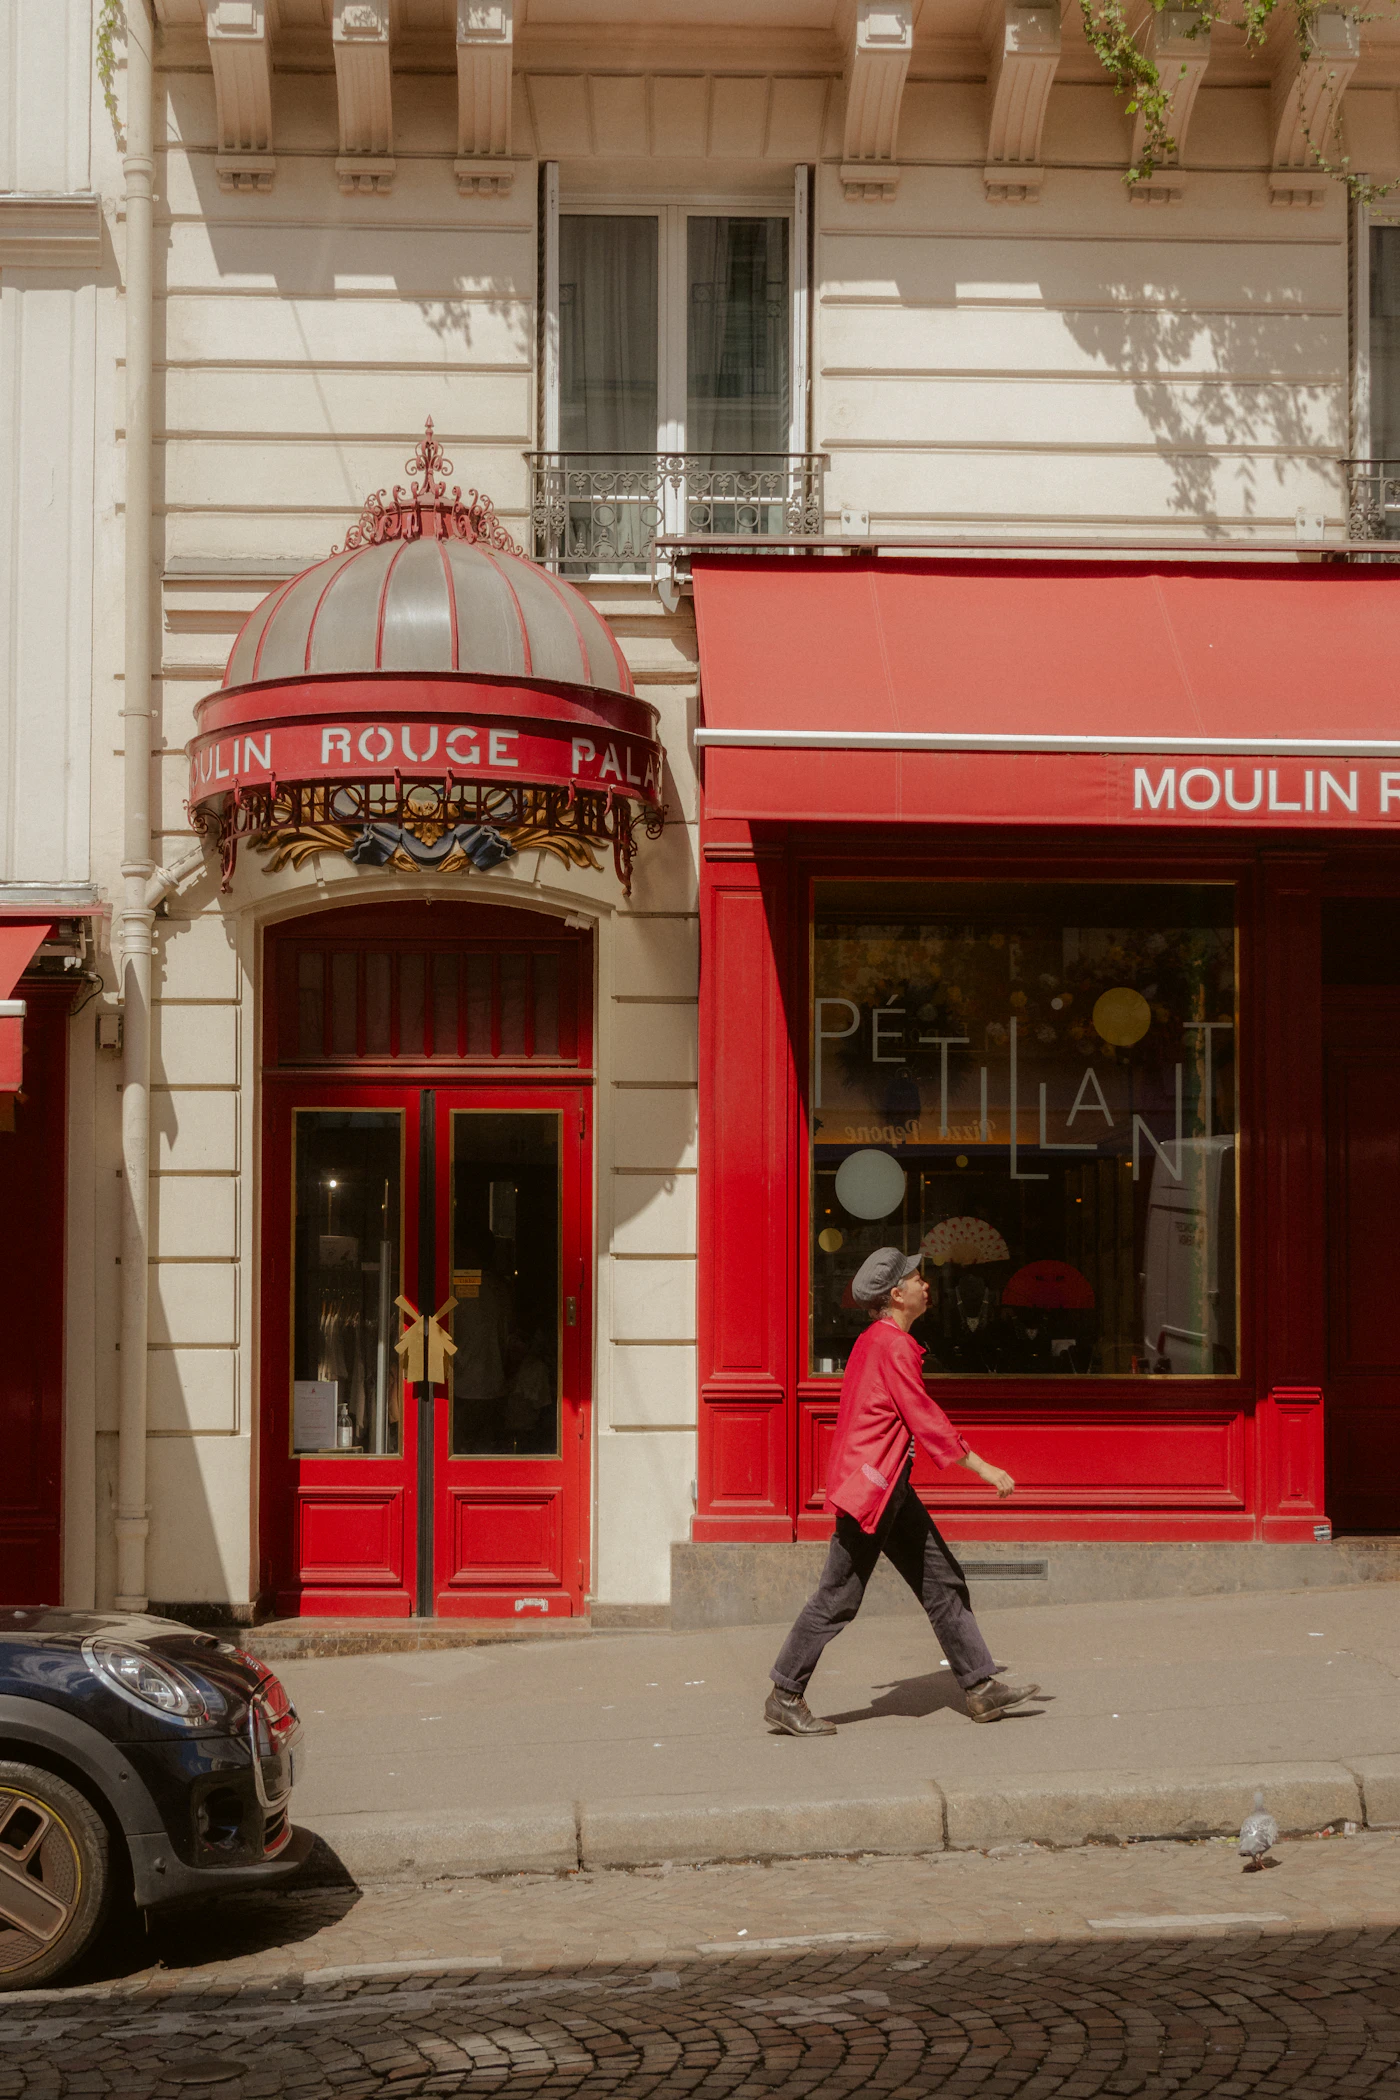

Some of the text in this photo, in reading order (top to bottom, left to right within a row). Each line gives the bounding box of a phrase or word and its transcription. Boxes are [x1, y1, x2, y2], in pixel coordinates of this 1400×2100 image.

[321, 725, 520, 767] ROUGE
[571, 737, 658, 789] PALA
[1133, 768, 1358, 812] MOULIN
[814, 994, 1234, 1181] PÉTILLANT
